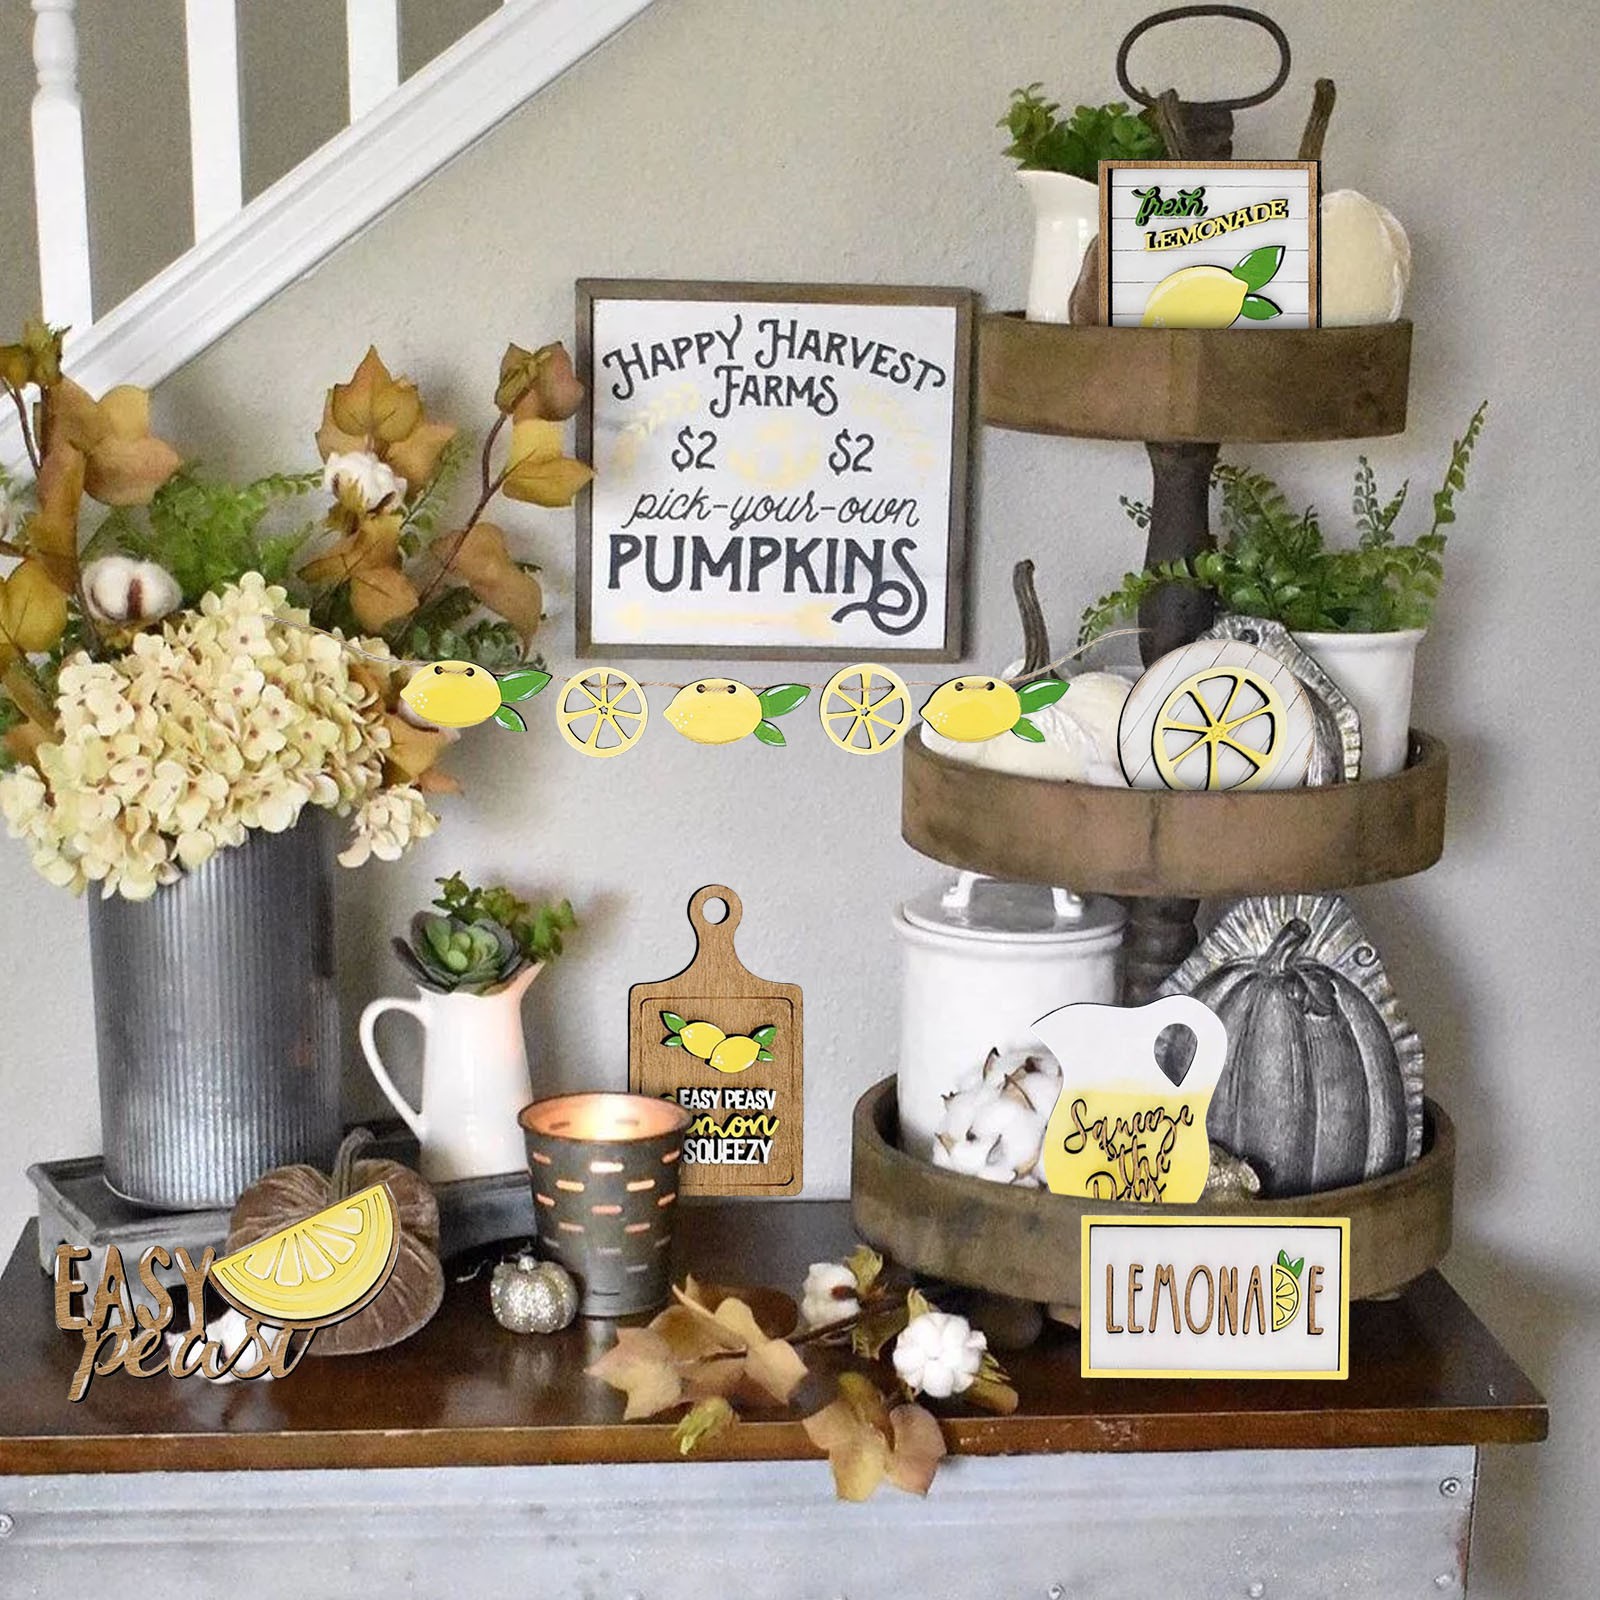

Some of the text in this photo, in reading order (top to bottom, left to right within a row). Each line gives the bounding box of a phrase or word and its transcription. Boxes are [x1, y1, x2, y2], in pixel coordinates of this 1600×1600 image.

[1131, 185, 1208, 226] fresh
[1144, 199, 1288, 252] LEMONADE
[602, 314, 946, 401] HAPPY HARVEST
[709, 364, 839, 418] FARMS
[671, 425, 875, 476] $2 $2
[621, 486, 920, 530] pick-your-own
[608, 533, 927, 635] PUMPKINS
[677, 1108, 780, 1138] mon
[678, 1088, 777, 1110] EASY PEASY
[683, 1138, 774, 1165] SQUEEZY
[1064, 1099, 1194, 1158] Squeeze
[1116, 1135, 1171, 1186] the
[55, 1244, 216, 1332] EASY
[1106, 1258, 1325, 1336] LEMONADE
